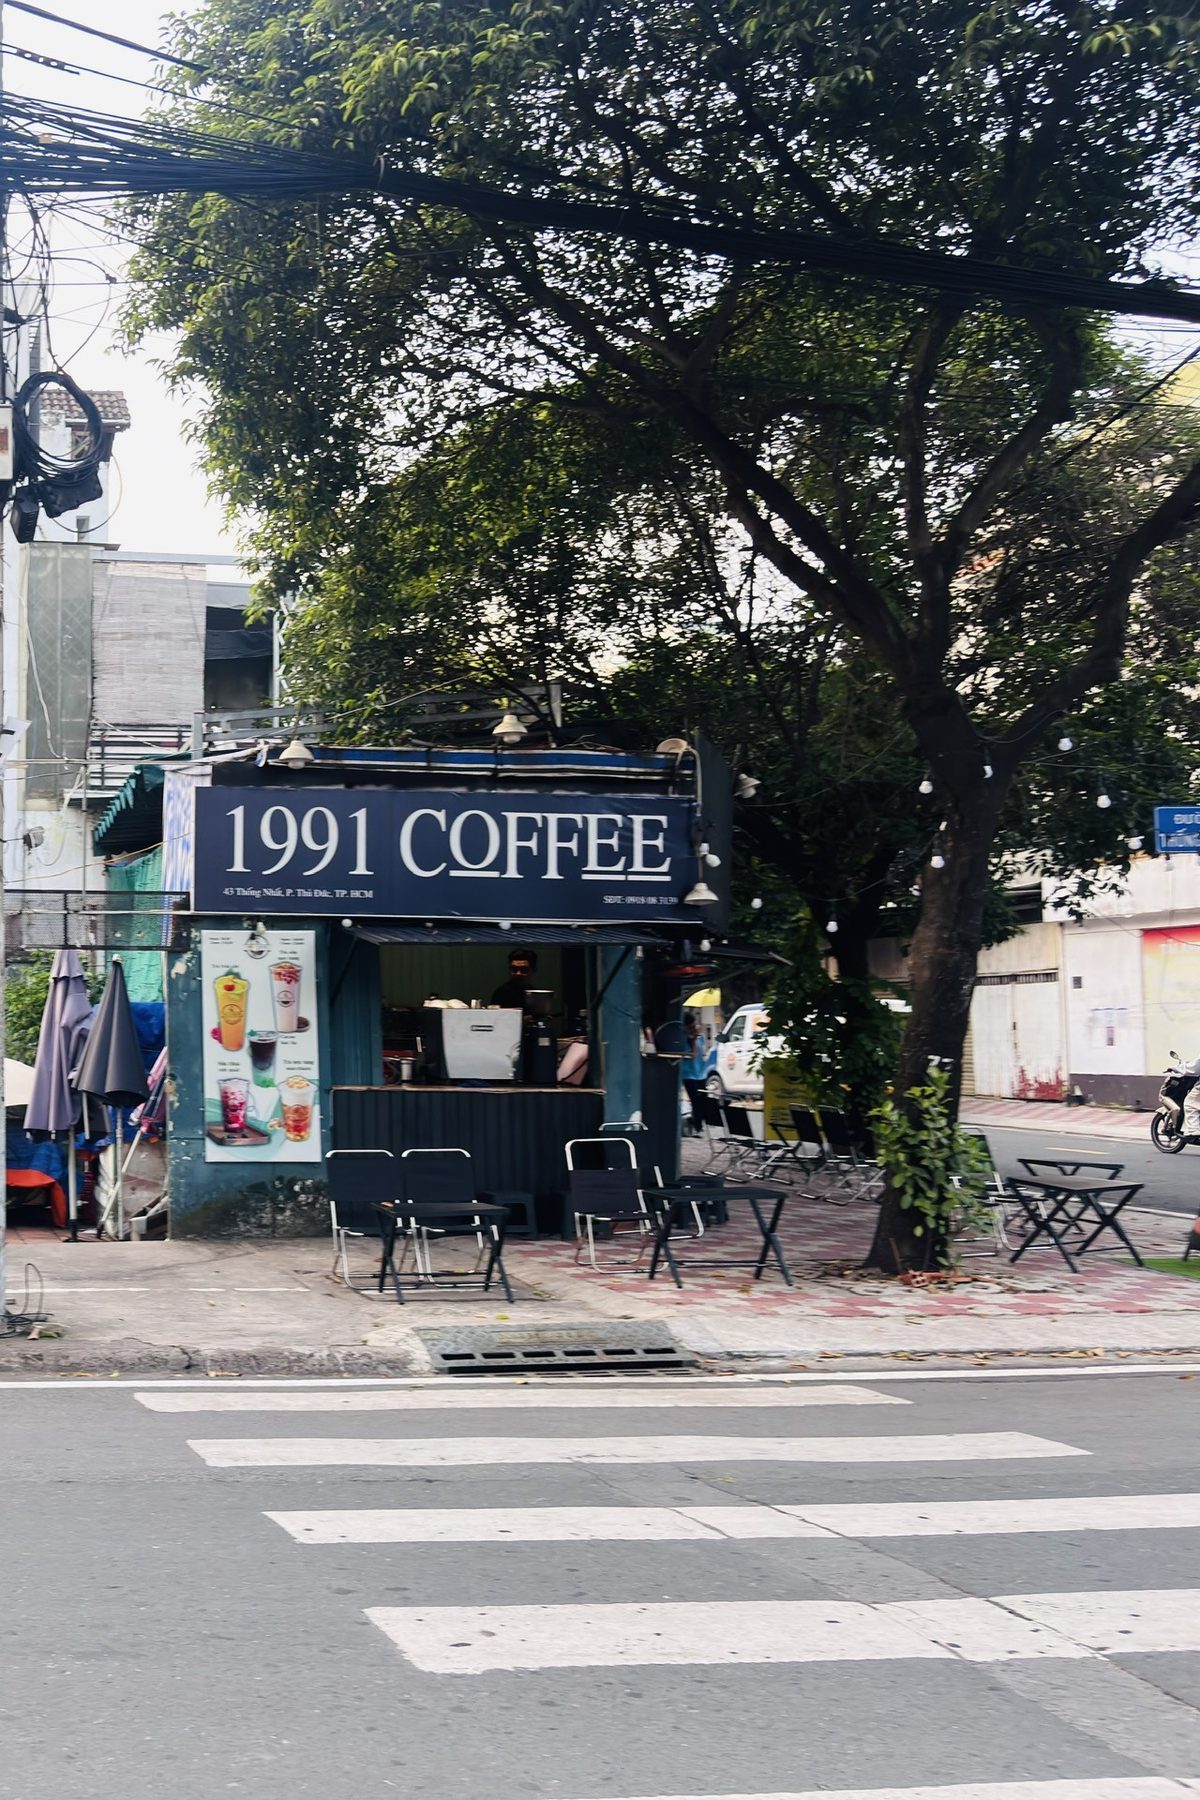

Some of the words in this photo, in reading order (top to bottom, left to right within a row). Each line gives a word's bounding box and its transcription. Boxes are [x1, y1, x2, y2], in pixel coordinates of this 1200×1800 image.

[225, 804, 375, 876] 1991
[399, 808, 672, 881] COFFEE
[350, 889, 374, 898] HCM
